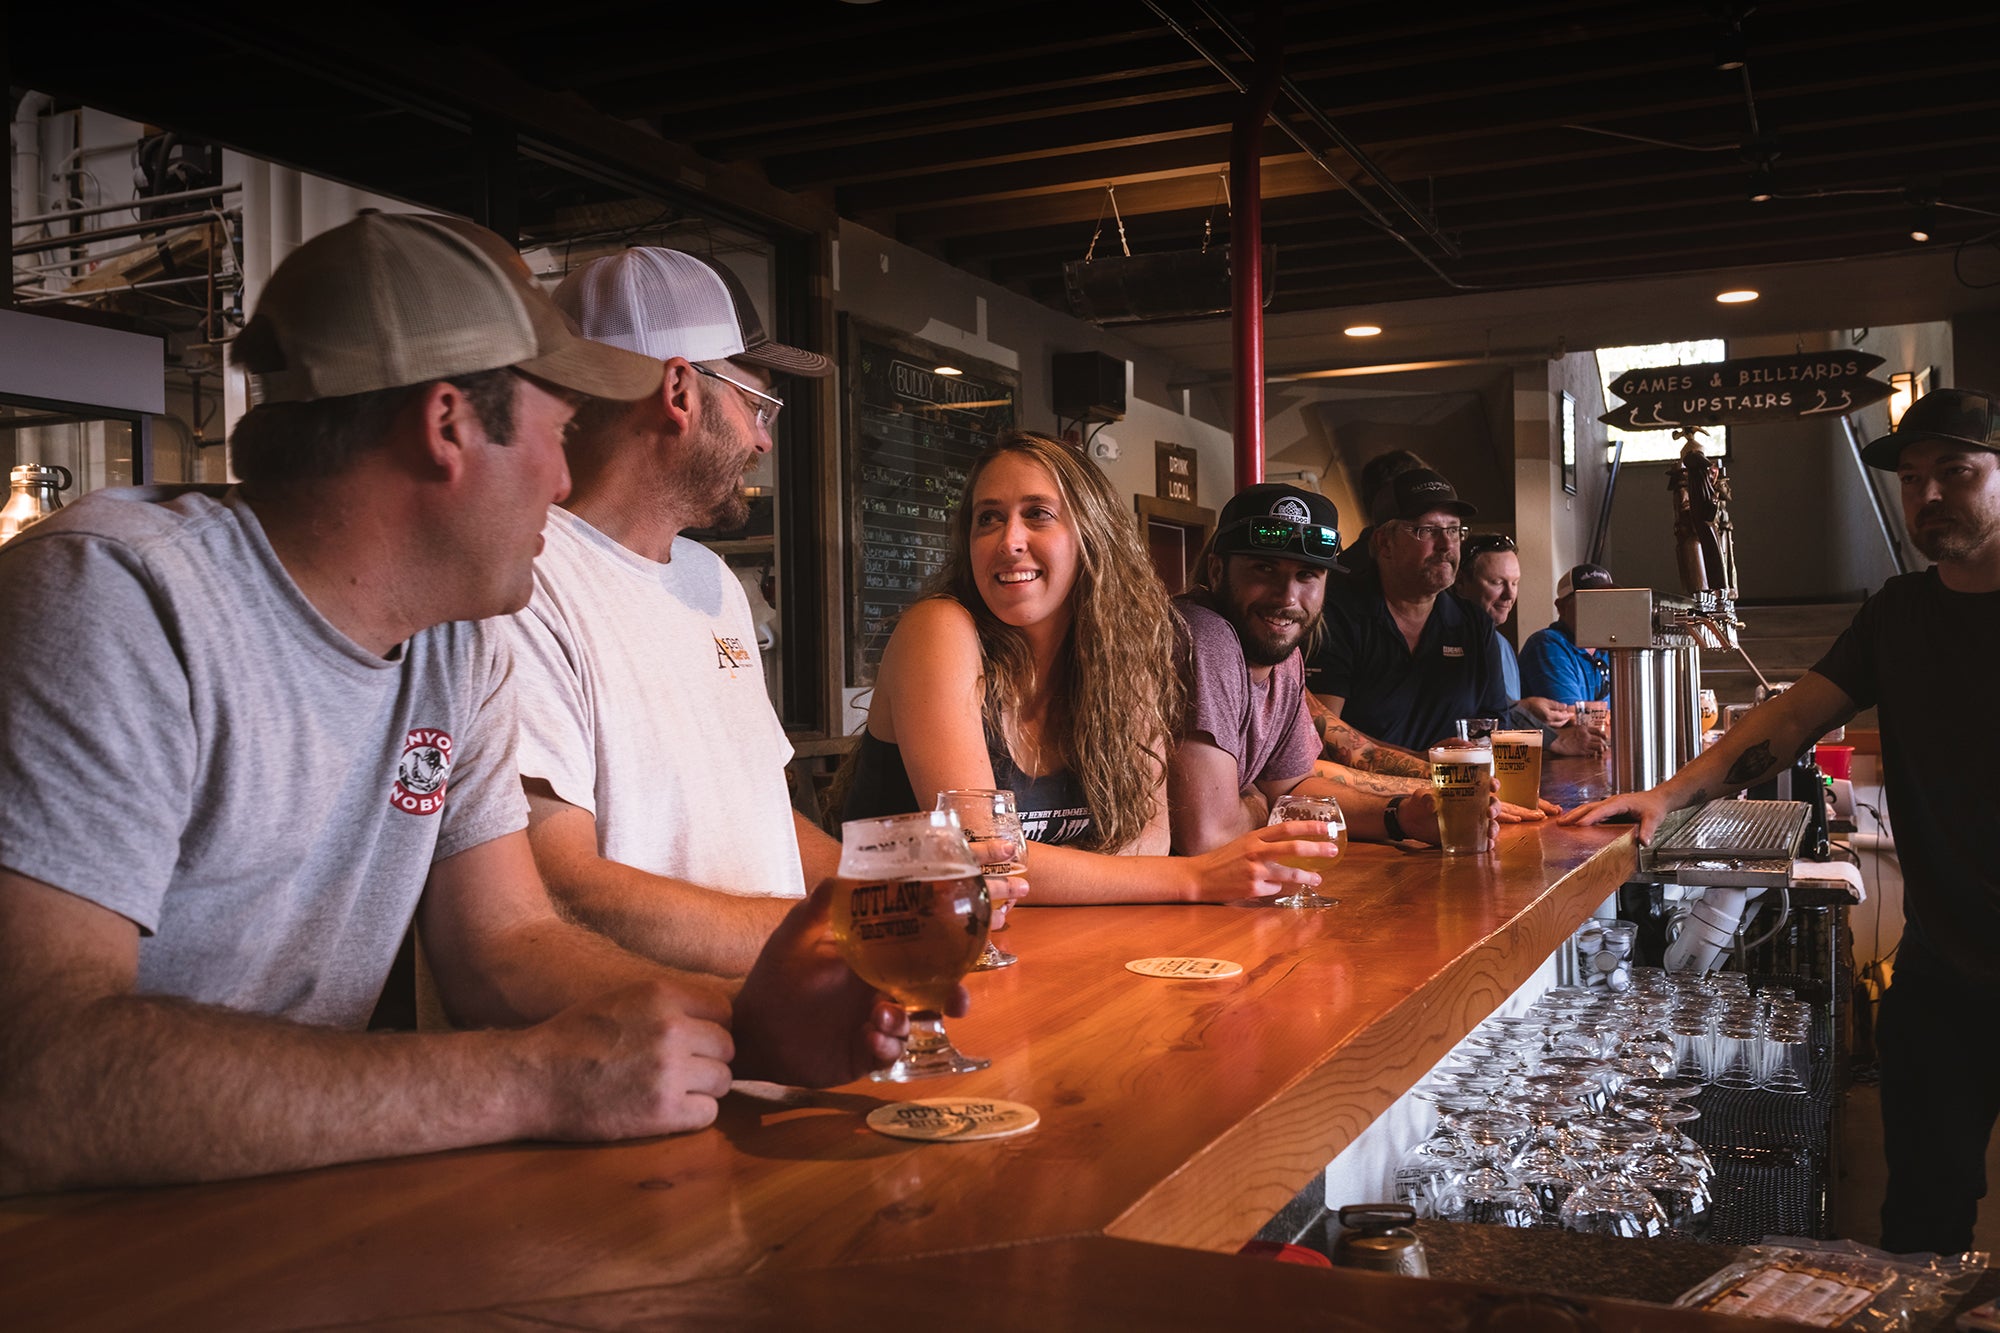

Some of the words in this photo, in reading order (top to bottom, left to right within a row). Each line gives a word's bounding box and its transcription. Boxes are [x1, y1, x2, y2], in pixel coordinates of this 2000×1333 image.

[896, 365, 936, 400] BUDDY
[944, 379, 982, 410] BOARD
[1623, 376, 1692, 395] GAMES
[1710, 372, 1722, 388] &
[1738, 361, 1858, 386] BILLIARDS
[1683, 392, 1793, 413] UPSTAIRS
[1169, 480, 1190, 500] LOCAL
[404, 731, 452, 755] NYO
[392, 785, 446, 812] NOBL
[897, 1104, 994, 1119] OUTLAW
